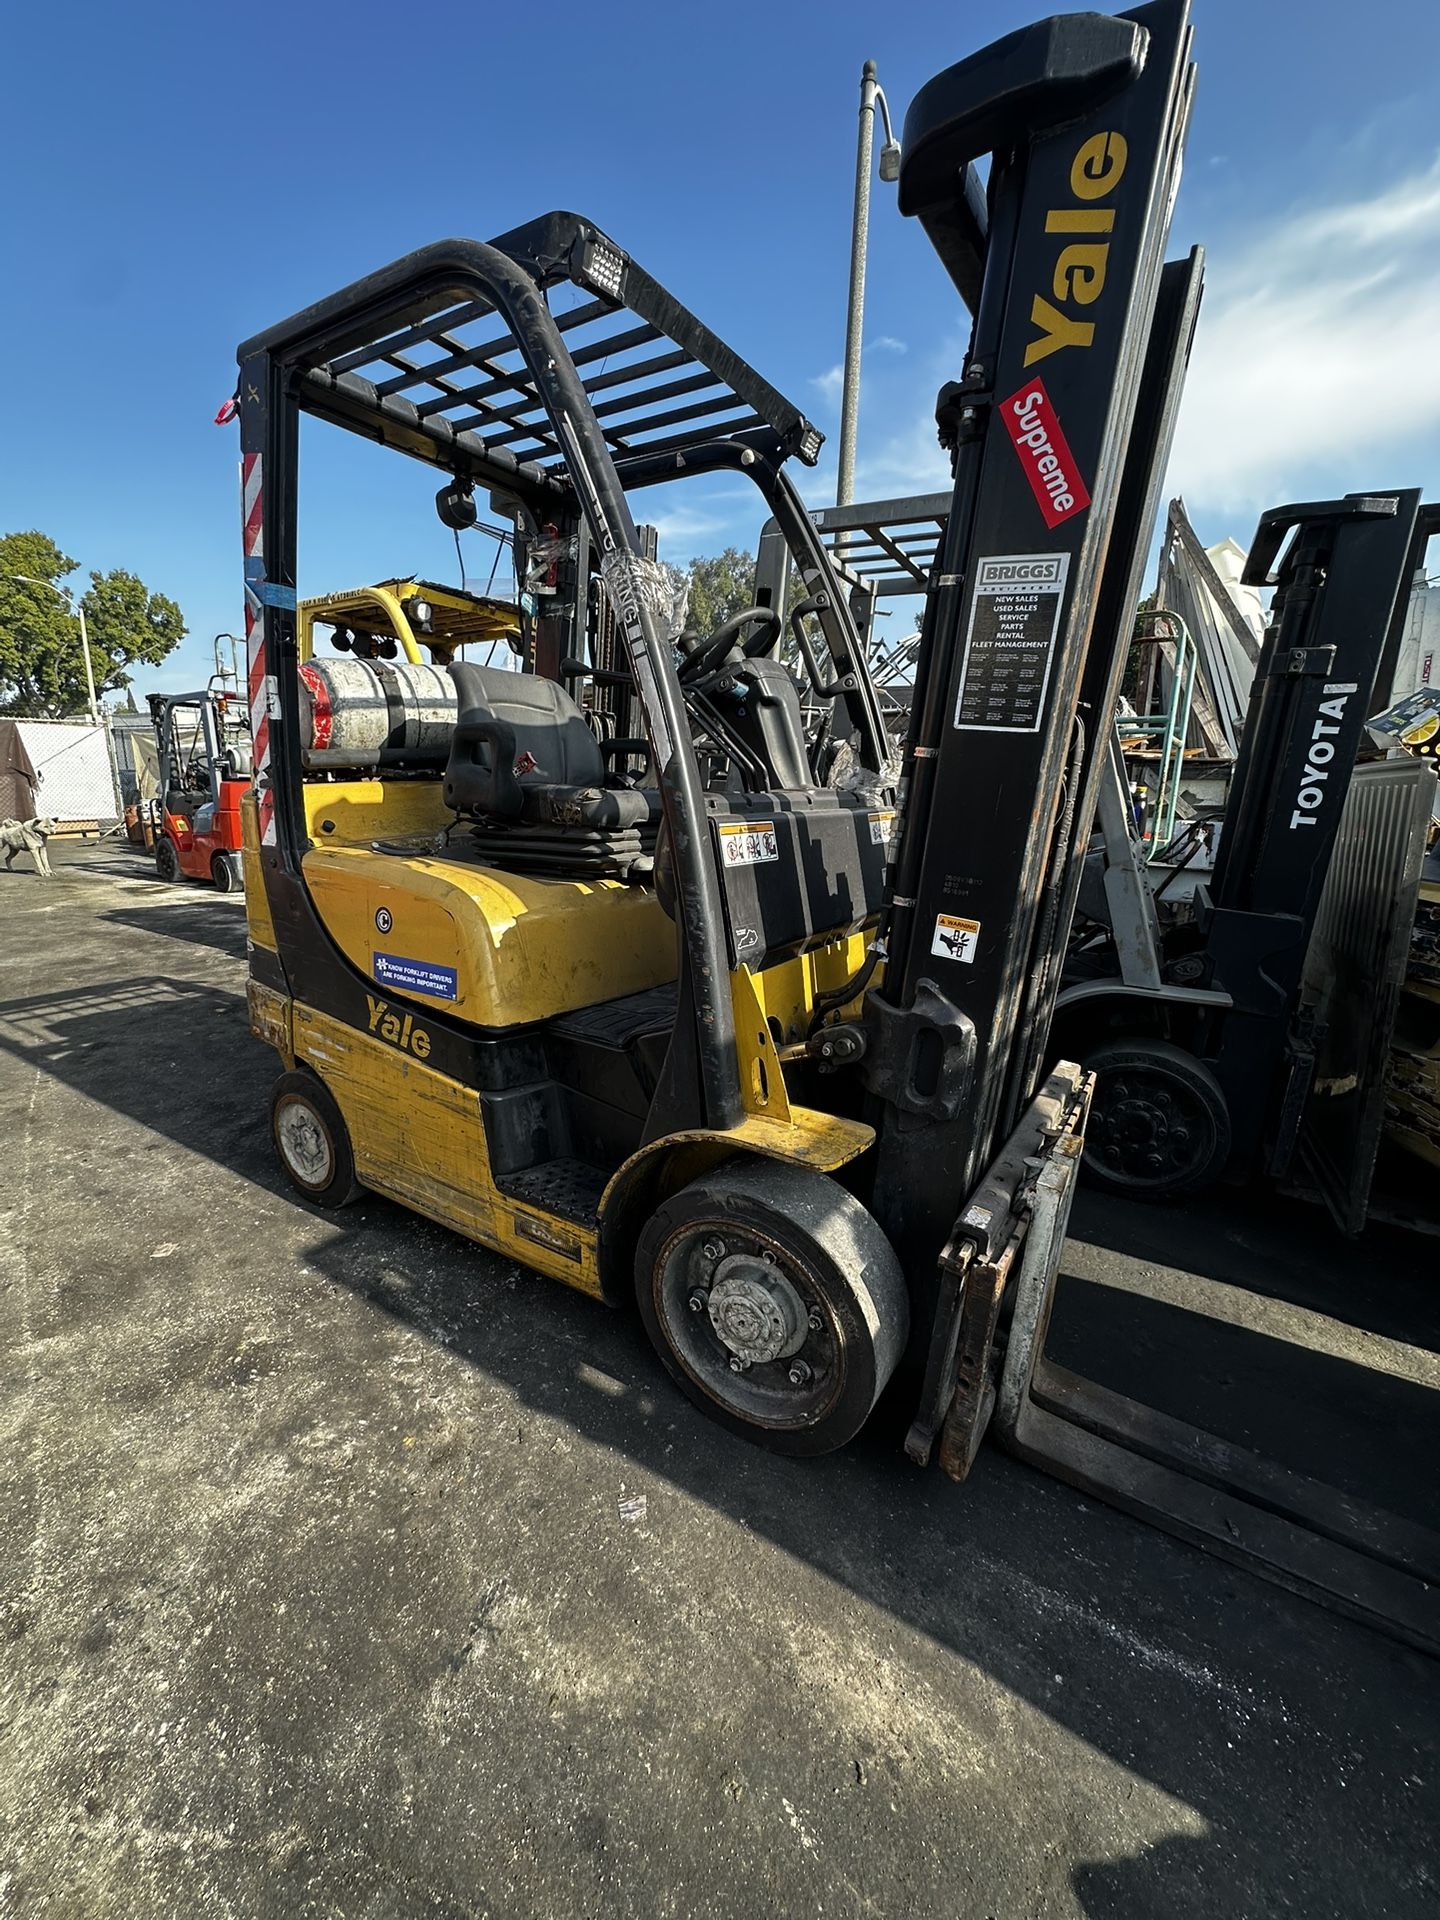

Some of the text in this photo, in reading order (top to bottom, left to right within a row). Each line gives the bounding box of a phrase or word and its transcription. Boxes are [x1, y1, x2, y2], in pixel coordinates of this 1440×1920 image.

[1023, 131, 1128, 368] Yale
[1013, 391, 1075, 512] Supreme
[986, 564, 1054, 580] BRIGGS
[1015, 594, 1039, 602] SALES
[1014, 604, 1038, 612] SALES
[1289, 696, 1348, 829] TOYOTA
[394, 973, 416, 983] FORKING
[404, 967, 428, 978] FORKLIFT
[429, 973, 453, 983] DRIVERS
[366, 994, 431, 1058] Yale
